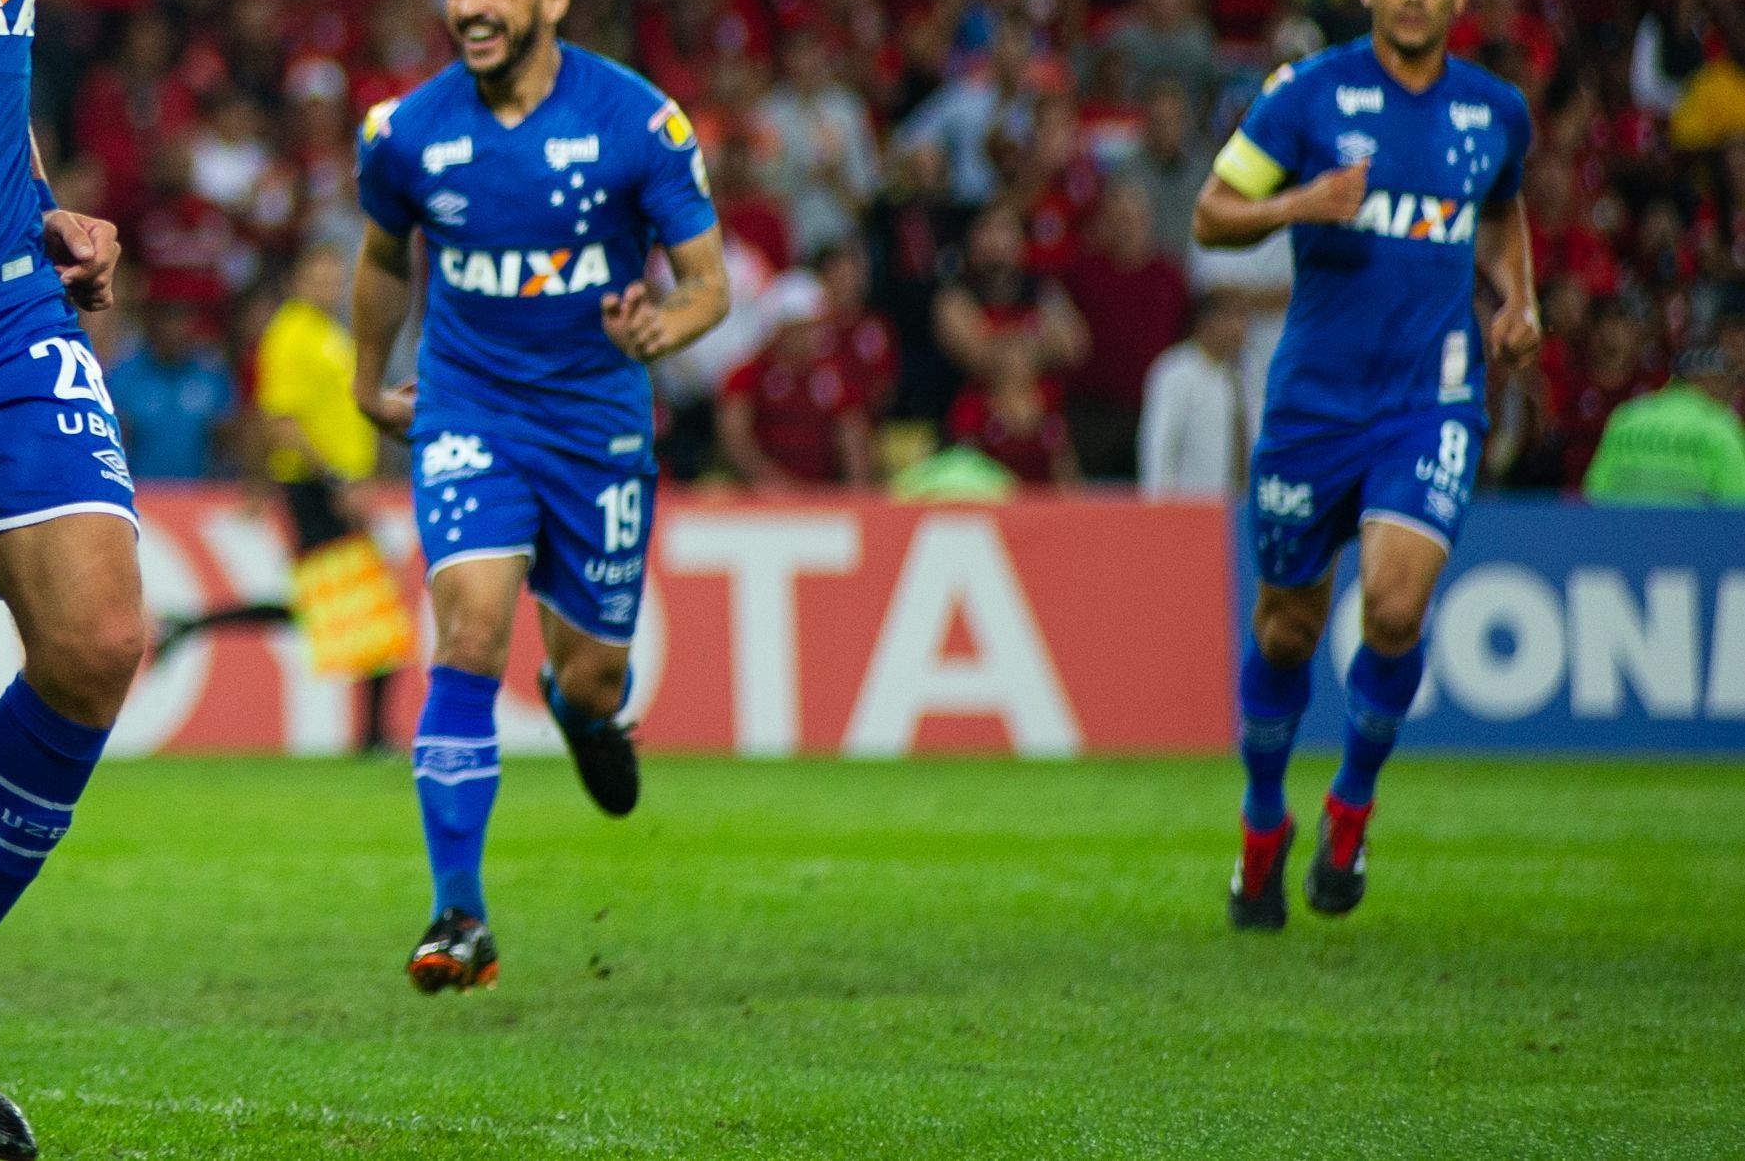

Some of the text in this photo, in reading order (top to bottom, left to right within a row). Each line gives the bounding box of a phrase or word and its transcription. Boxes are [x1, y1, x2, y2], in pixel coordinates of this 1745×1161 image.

[439, 242, 611, 298] CAIXA
[29, 336, 114, 415] 28
[421, 430, 494, 478] abc
[1438, 420, 1469, 479] 8
[595, 478, 642, 553] 19
